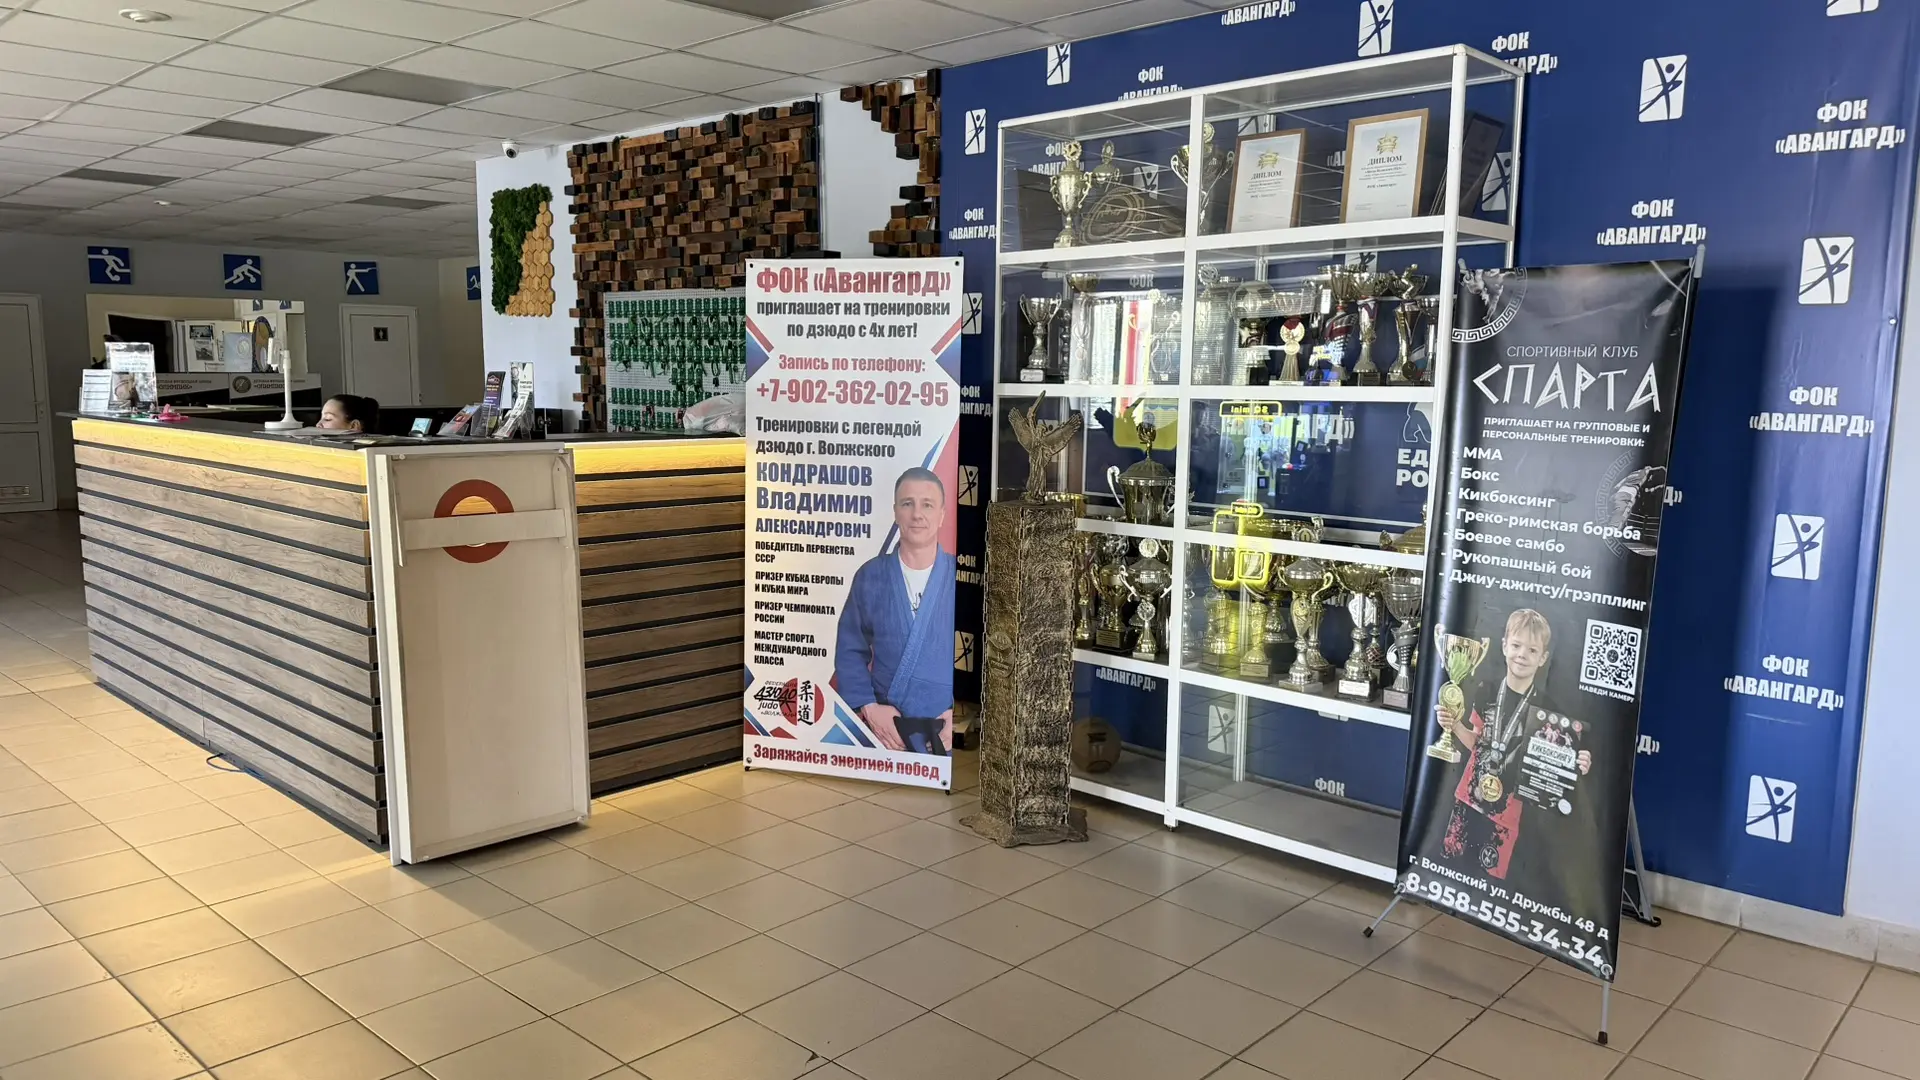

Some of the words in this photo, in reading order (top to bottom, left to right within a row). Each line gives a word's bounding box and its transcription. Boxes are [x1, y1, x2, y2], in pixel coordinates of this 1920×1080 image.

[1220, 1, 1296, 26] «АВАНГАРД»
[1492, 31, 1530, 53] ФОК
[1138, 65, 1164, 83] ФОК
[1816, 99, 1869, 122] ФОК
[1775, 125, 1906, 154] «АВАНГАРД»
[1367, 155, 1403, 166] ДИПЛОМ
[1251, 171, 1282, 180] ДИПЛОМ
[964, 208, 984, 221] ФОК
[1631, 199, 1674, 218] ФОК
[1596, 223, 1706, 246] «АВАНГАРД»
[757, 267, 808, 293] ФОК
[814, 267, 951, 297] «Авангард»
[1129, 273, 1154, 288] ФОК
[757, 301, 841, 316] приглашает
[844, 303, 861, 315] на
[864, 301, 950, 317] тренировки
[787, 323, 804, 337] по
[806, 323, 855, 339] дзюдо
[858, 325, 867, 337] с
[869, 322, 885, 337] 4х
[887, 322, 918, 338] лет!
[1507, 343, 1597, 358] СПОРТИВНЫЙ
[1602, 346, 1639, 358] КЛУБ
[779, 355, 829, 371] Запись
[832, 357, 848, 371] по
[851, 356, 926, 373] телефону:
[757, 379, 949, 407] +7-902-362-02-95
[961, 385, 980, 398] ФОК
[1473, 361, 1661, 413] СПАРТА
[1788, 386, 1838, 407] ФОК
[756, 416, 838, 434] Тренировки
[841, 421, 850, 434] с
[852, 421, 922, 438] легендой
[1484, 417, 1553, 429] ПРИГЛАШАЕТ
[1555, 420, 1571, 430] НА
[1573, 421, 1640, 433] ГРУППОВЫЕ
[1643, 424, 1650, 433] И
[1749, 412, 1875, 437] «АВАНГАРД»
[1482, 429, 1568, 443] ПЕРСОНАЛЬНЫЕ
[1570, 434, 1645, 447] ТРЕНИРОВКИ:
[756, 440, 804, 456] дзюдо
[806, 442, 816, 455] г.
[818, 442, 895, 458] Волжского
[1463, 447, 1503, 461] ММА
[756, 462, 872, 486] КОНДРАШОВ
[1461, 467, 1500, 482] Бокс
[756, 487, 872, 516] Владимир
[1458, 487, 1556, 508] Кикбоксинг
[756, 518, 871, 539] АЛЕКСАНДРОВИЧ
[1456, 508, 1579, 534] Греко-римская
[1582, 521, 1641, 541] борьба
[755, 541, 804, 553] ПОБЕДИТЕЛЬ
[806, 543, 855, 555] ПЕРВЕНСТВА
[1454, 528, 1512, 547] Боевое
[1515, 537, 1566, 554] самбо
[755, 554, 776, 563] СССР
[957, 553, 976, 567] ФОК
[1452, 548, 1557, 577] Рукопашный
[1560, 561, 1592, 580] бой
[755, 571, 784, 581] ПРИЗЕР
[785, 572, 810, 583] КУБКА
[811, 575, 844, 586] ЕВРОПЫ
[755, 584, 760, 593] И
[761, 584, 786, 595] КУБКА
[787, 586, 809, 596] МИРА
[1449, 568, 1647, 612] Джиу-джитсу/грэпплинг
[755, 601, 783, 612] ПРИЗЕР
[784, 603, 836, 615] ЧЕМПИОНАТА
[754, 614, 785, 624] РОССИИ
[754, 630, 784, 641] МАСТЕР
[785, 632, 815, 644] СПОРТА
[754, 643, 827, 657] МЕЖДУНАРОДНОГО
[754, 656, 784, 666] КЛАССА
[1762, 654, 1809, 678] ФОК
[1096, 667, 1156, 692] «АВАНГАРД»
[1579, 684, 1608, 697] НАВЕДИ
[1609, 689, 1635, 703] КАМЕРУ
[1723, 675, 1843, 711] «АВАНГАРД»
[758, 701, 778, 710] judo
[754, 744, 828, 765] Заряжайся
[831, 752, 893, 773] энергией
[896, 760, 940, 780] побед
[1314, 777, 1345, 797] ФОК
[1409, 855, 1418, 866] г.
[1421, 857, 1488, 893] Волжский
[1491, 882, 1509, 902] ул.
[1512, 890, 1572, 925] Дружбы
[1575, 915, 1594, 932] 48
[1597, 926, 1609, 941] д
[1406, 872, 1604, 967] 8-958-555-34-34
